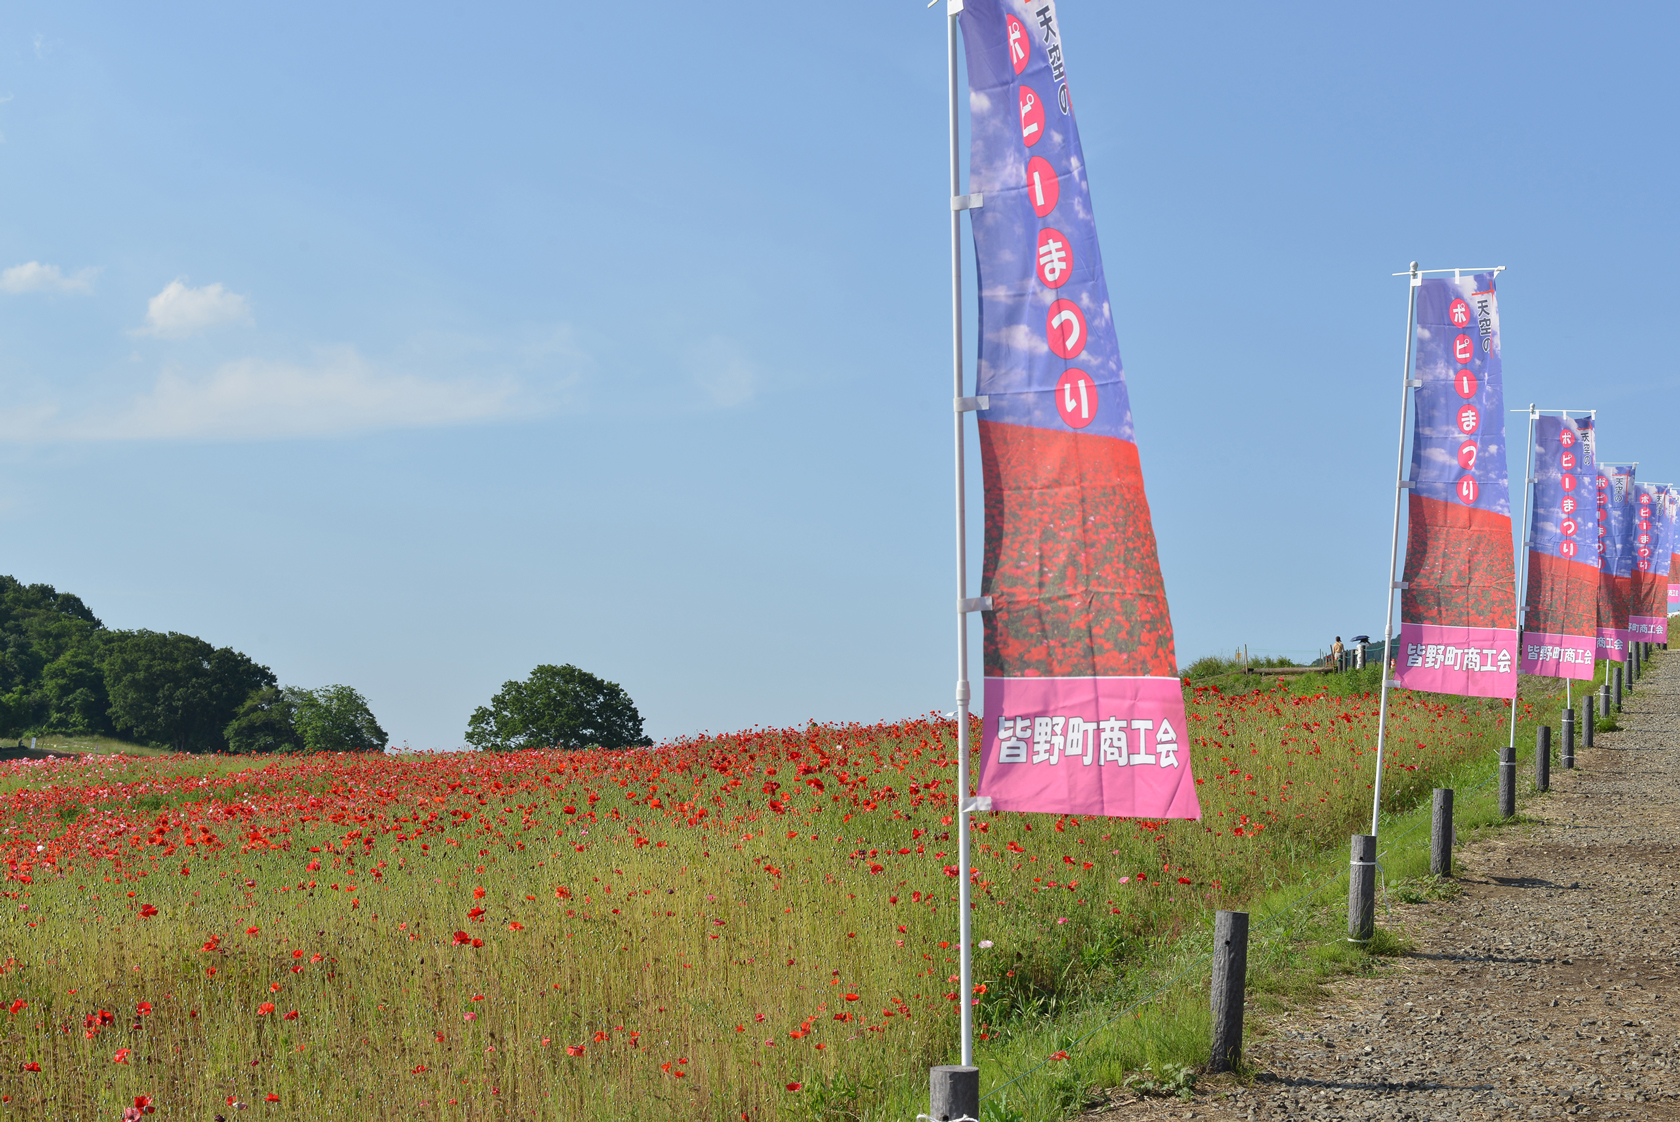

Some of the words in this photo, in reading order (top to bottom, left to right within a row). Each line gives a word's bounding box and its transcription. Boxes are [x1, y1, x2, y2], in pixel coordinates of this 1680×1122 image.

[1007, 21, 1090, 420] ポピーまつり
[1476, 298, 1491, 353] 天空の
[1452, 302, 1477, 500] ポピーまつり
[1580, 431, 1590, 466] 天空の
[1561, 432, 1575, 556] ポピーまつり
[1615, 477, 1624, 503] 天空の
[1639, 495, 1650, 570] ポピーまつり
[1406, 642, 1511, 674] 皆野町商工会
[1526, 643, 1592, 666] 皆野町商工会
[997, 715, 1180, 770] 皆野町商工会
